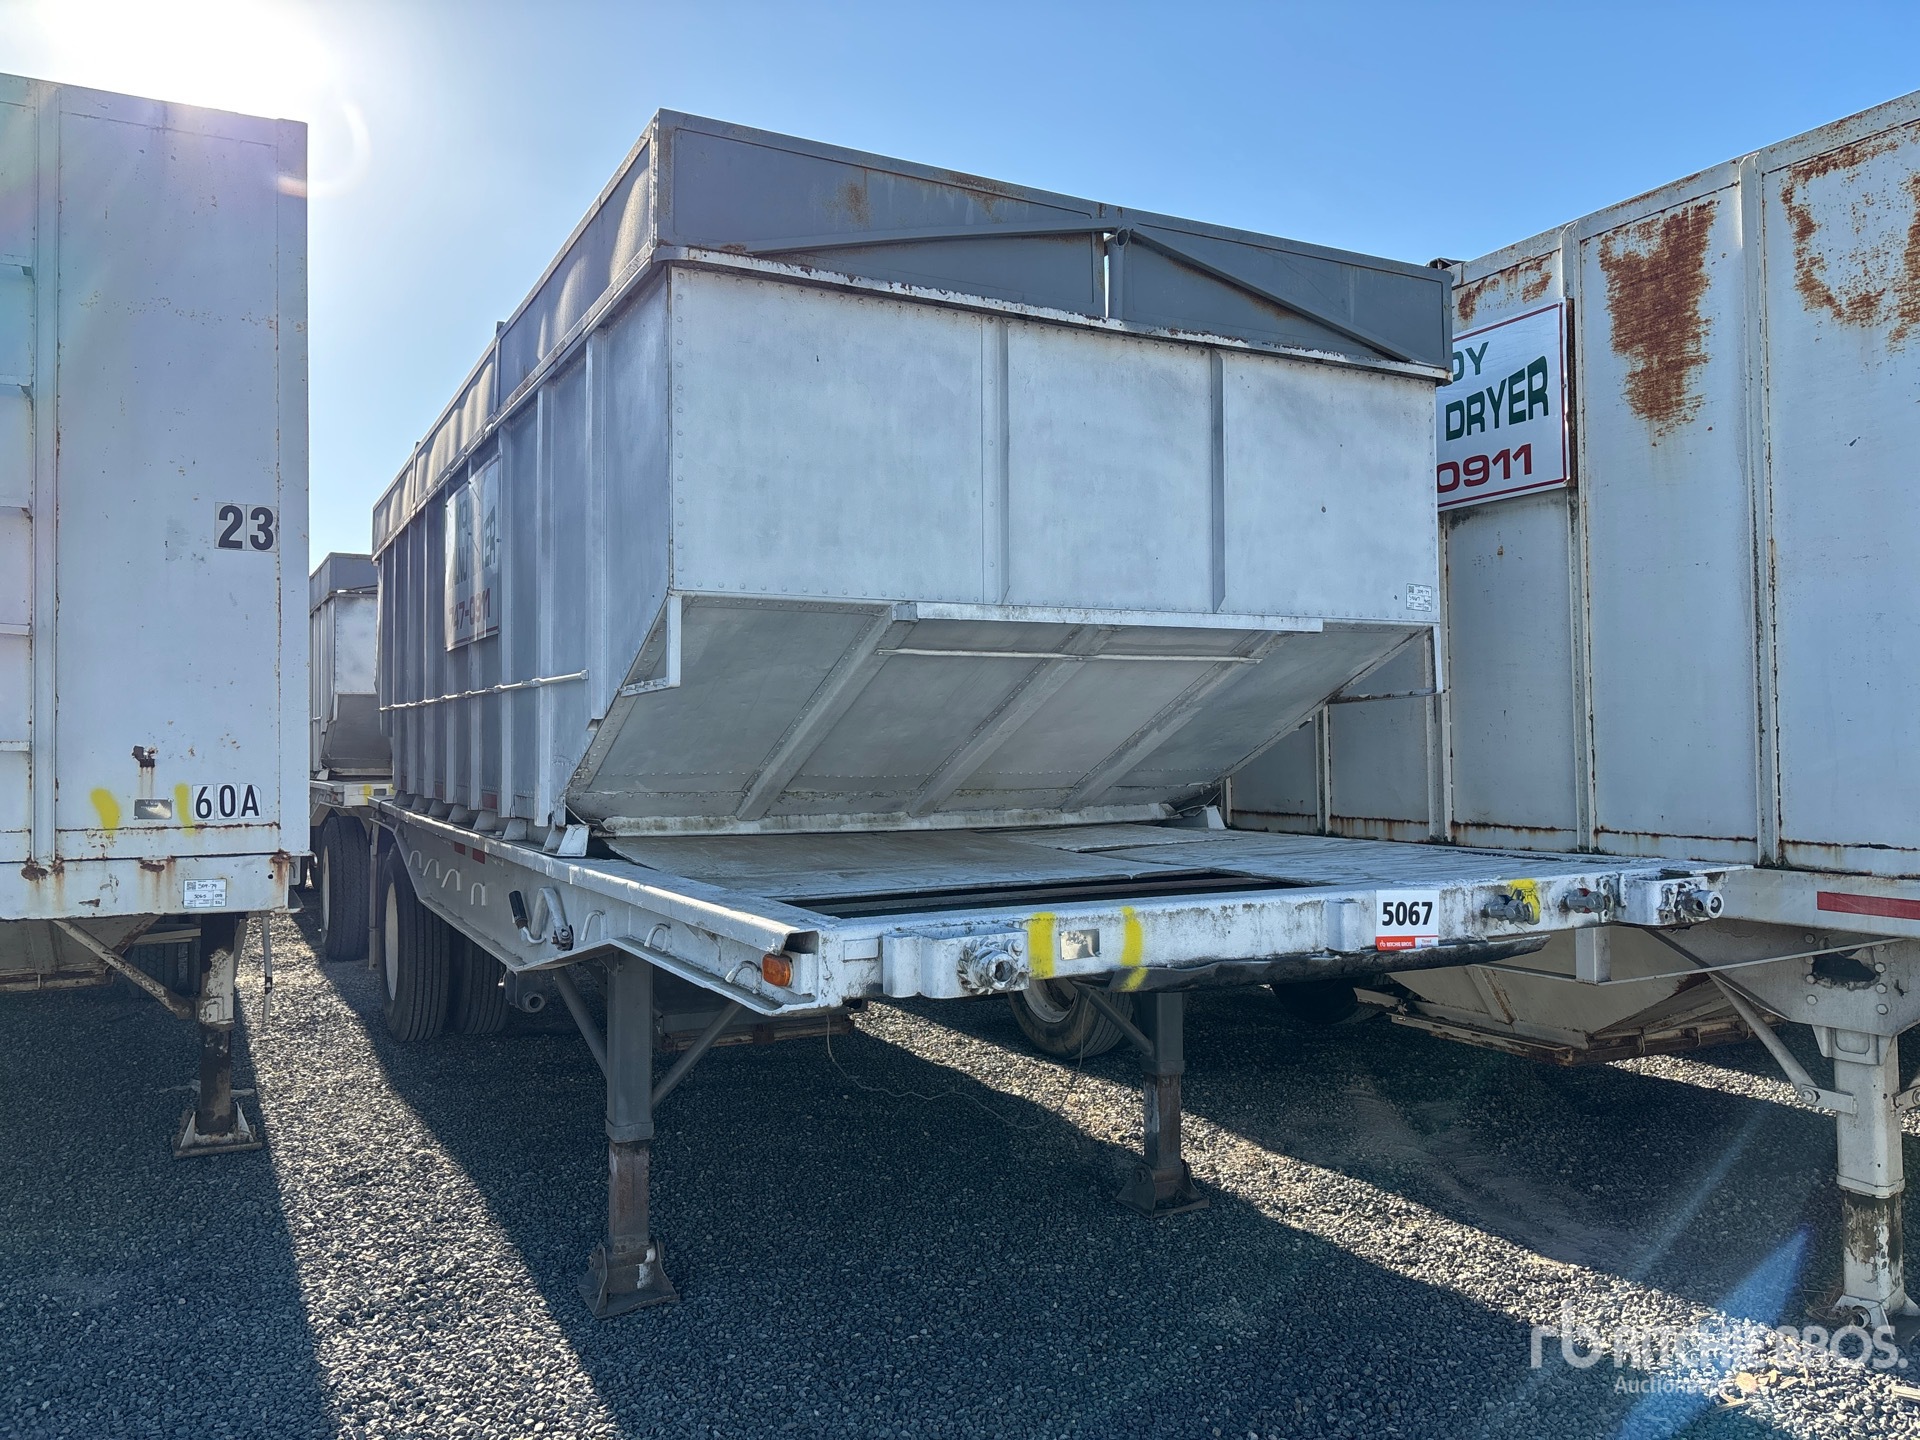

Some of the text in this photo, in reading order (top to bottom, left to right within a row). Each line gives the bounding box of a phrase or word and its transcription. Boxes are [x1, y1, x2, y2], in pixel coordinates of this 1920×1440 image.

[1445, 355, 1549, 441] DRYER
[218, 504, 274, 551] 23
[195, 784, 260, 819] 60A
[1382, 901, 1433, 926] 5067
